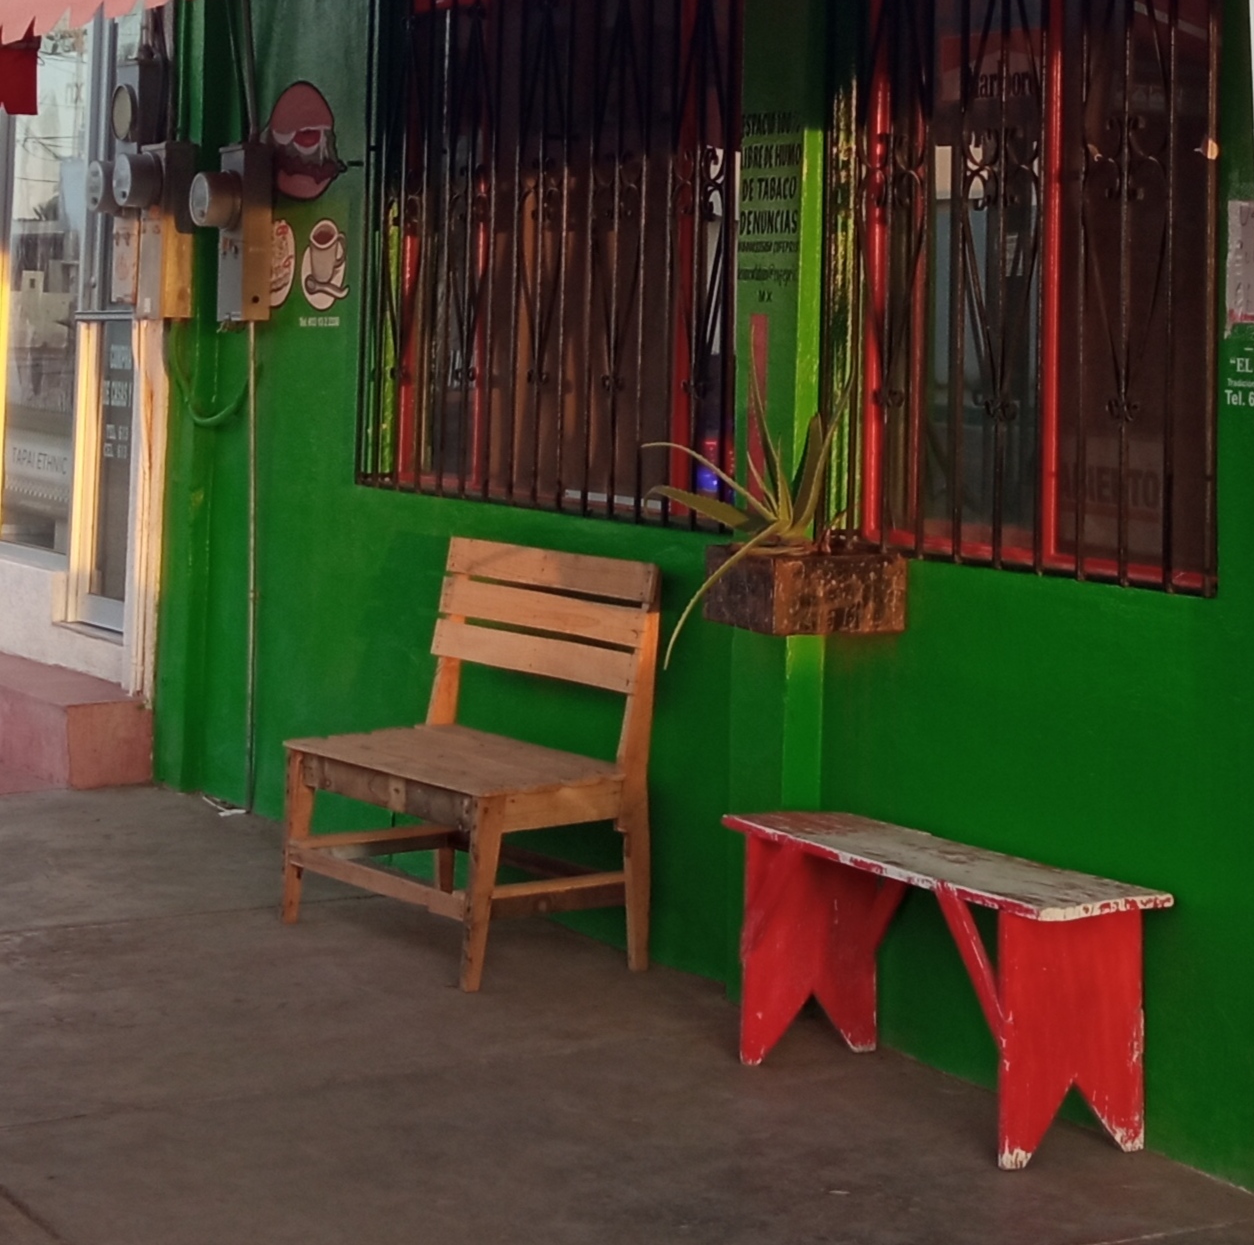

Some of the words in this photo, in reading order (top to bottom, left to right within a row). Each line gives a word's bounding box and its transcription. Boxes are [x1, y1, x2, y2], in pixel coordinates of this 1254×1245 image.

[742, 178, 755, 202] DE
[757, 176, 798, 201] TABACO
[739, 209, 798, 235] DENUNCIAS
[1224, 389, 1246, 406] Tel.
